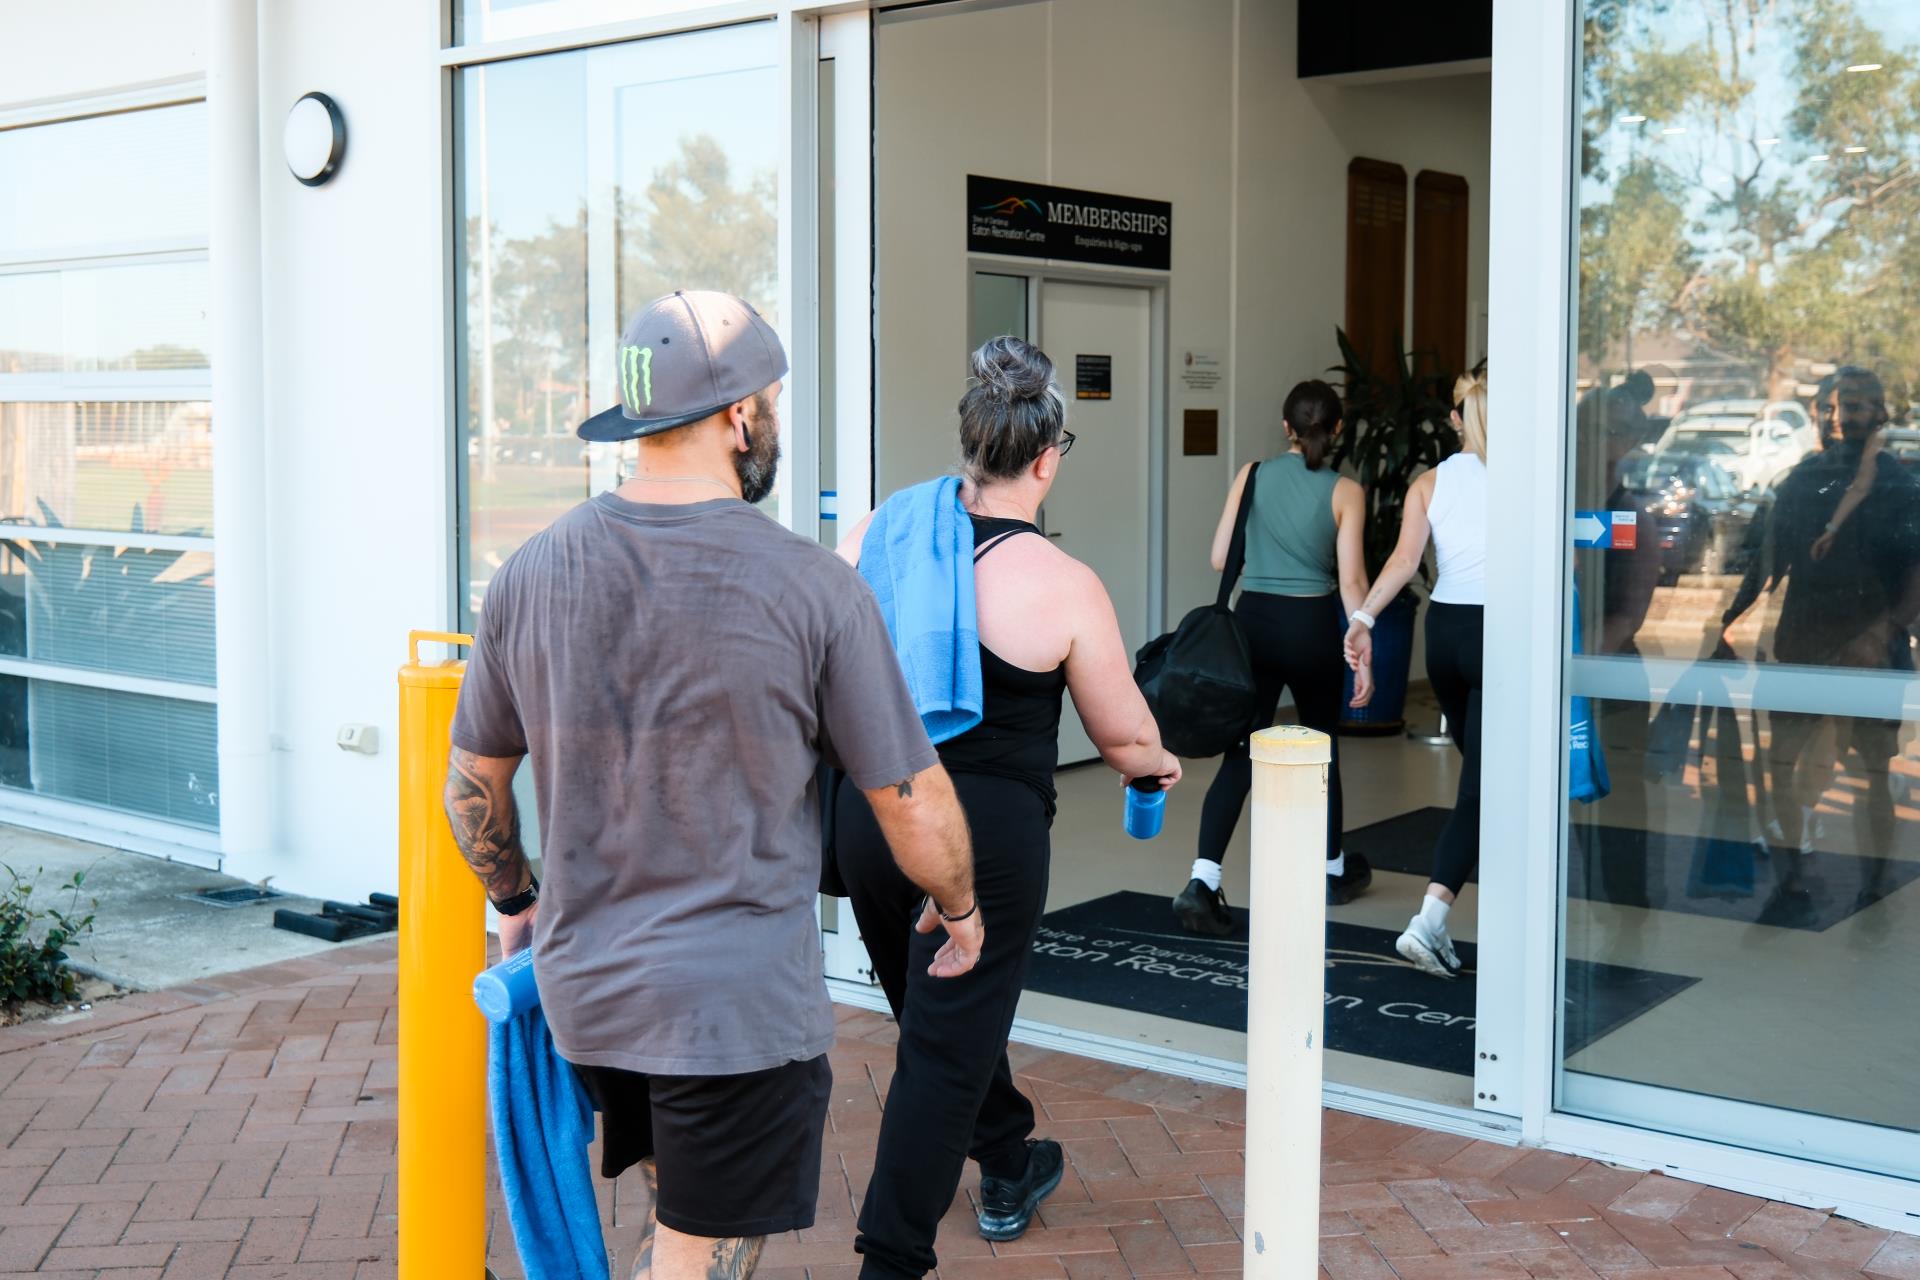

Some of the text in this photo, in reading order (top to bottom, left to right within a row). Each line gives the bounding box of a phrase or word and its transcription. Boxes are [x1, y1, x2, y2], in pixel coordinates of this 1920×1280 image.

[1047, 201, 1168, 236] MEMBERSHIPS
[972, 223, 1046, 242] Eaton Recreation Centre
[1091, 939, 1132, 948] of
